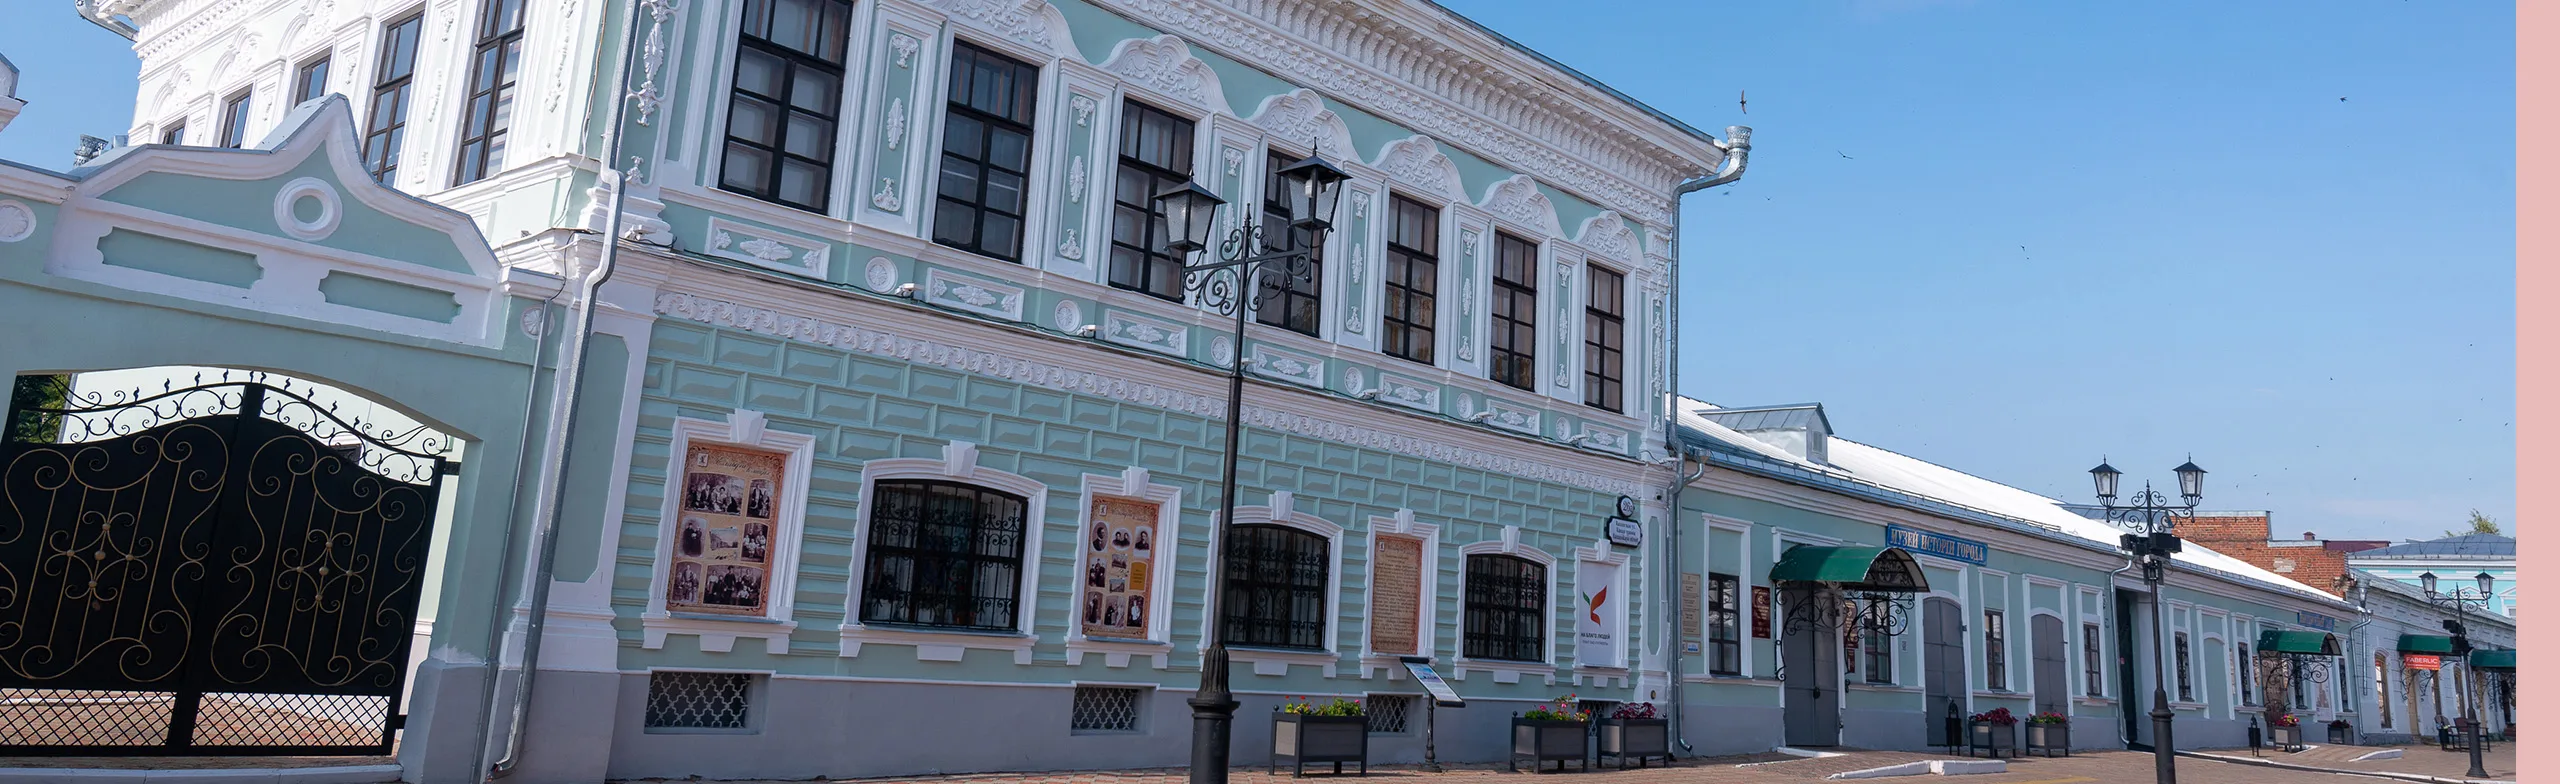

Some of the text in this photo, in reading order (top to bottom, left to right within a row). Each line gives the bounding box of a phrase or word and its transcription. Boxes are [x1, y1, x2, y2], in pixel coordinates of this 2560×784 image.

[1891, 528, 1919, 549] МУЗЕЙ
[1957, 542, 1984, 562] ГОРОДА
[2406, 656, 2438, 664] FABERLIC
